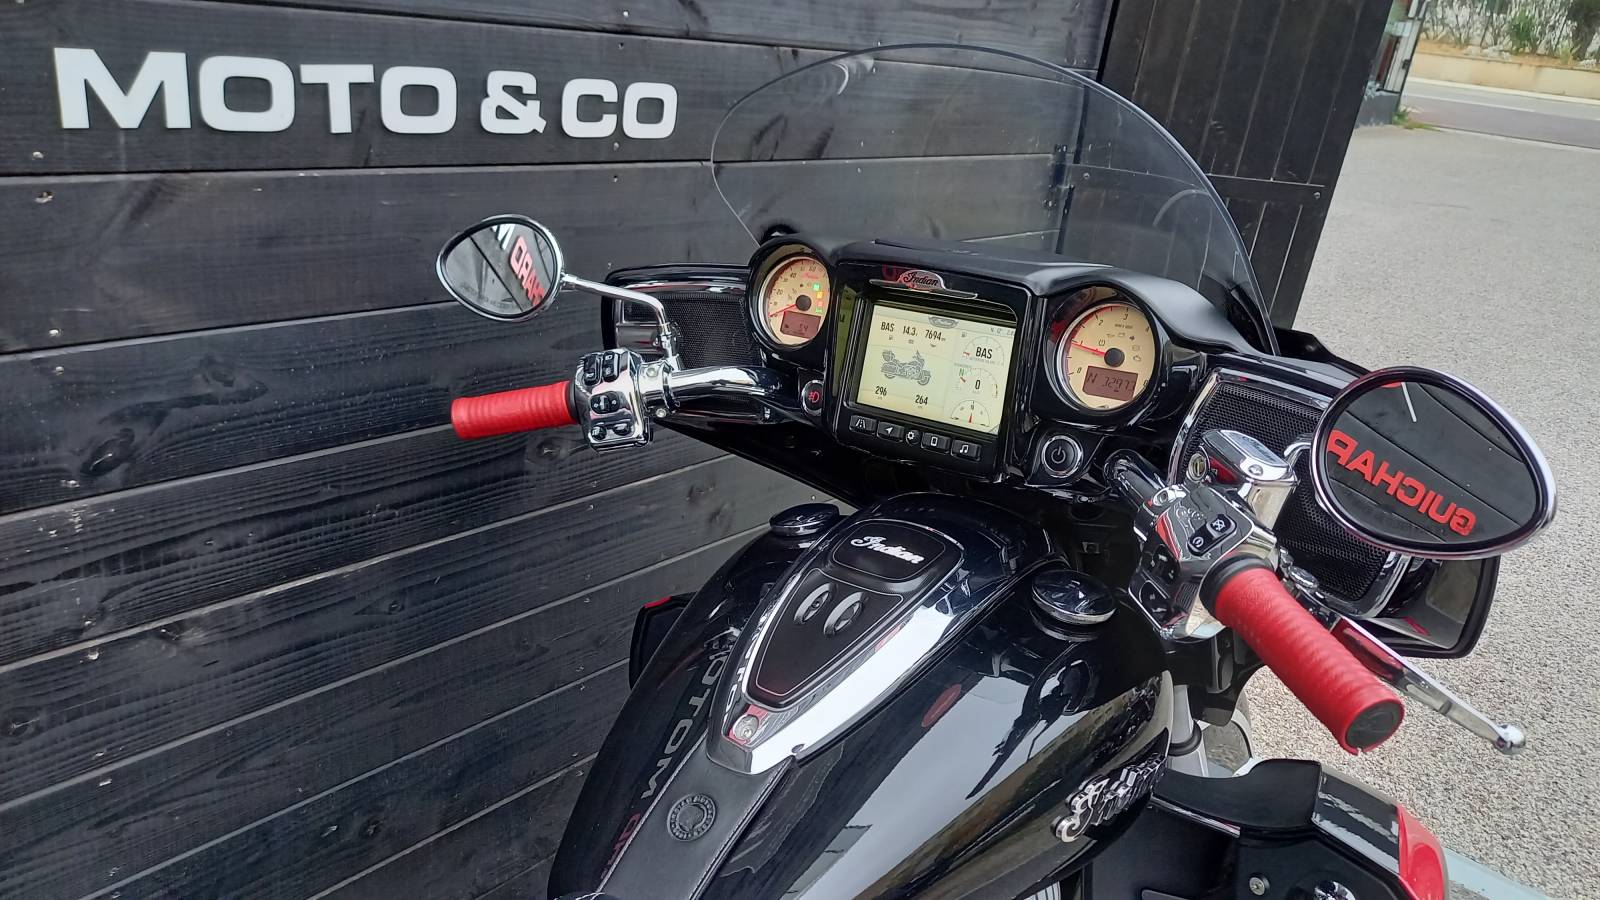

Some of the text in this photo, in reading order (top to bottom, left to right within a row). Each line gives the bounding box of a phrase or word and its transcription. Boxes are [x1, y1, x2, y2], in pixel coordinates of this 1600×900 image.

[54, 47, 678, 139] MOTO & CO
[903, 272, 939, 287] Indian
[880, 321, 895, 332] BAS
[975, 346, 993, 359] BAS
[874, 385, 888, 396] 296
[914, 394, 929, 406] 264
[850, 535, 925, 564] Indian
